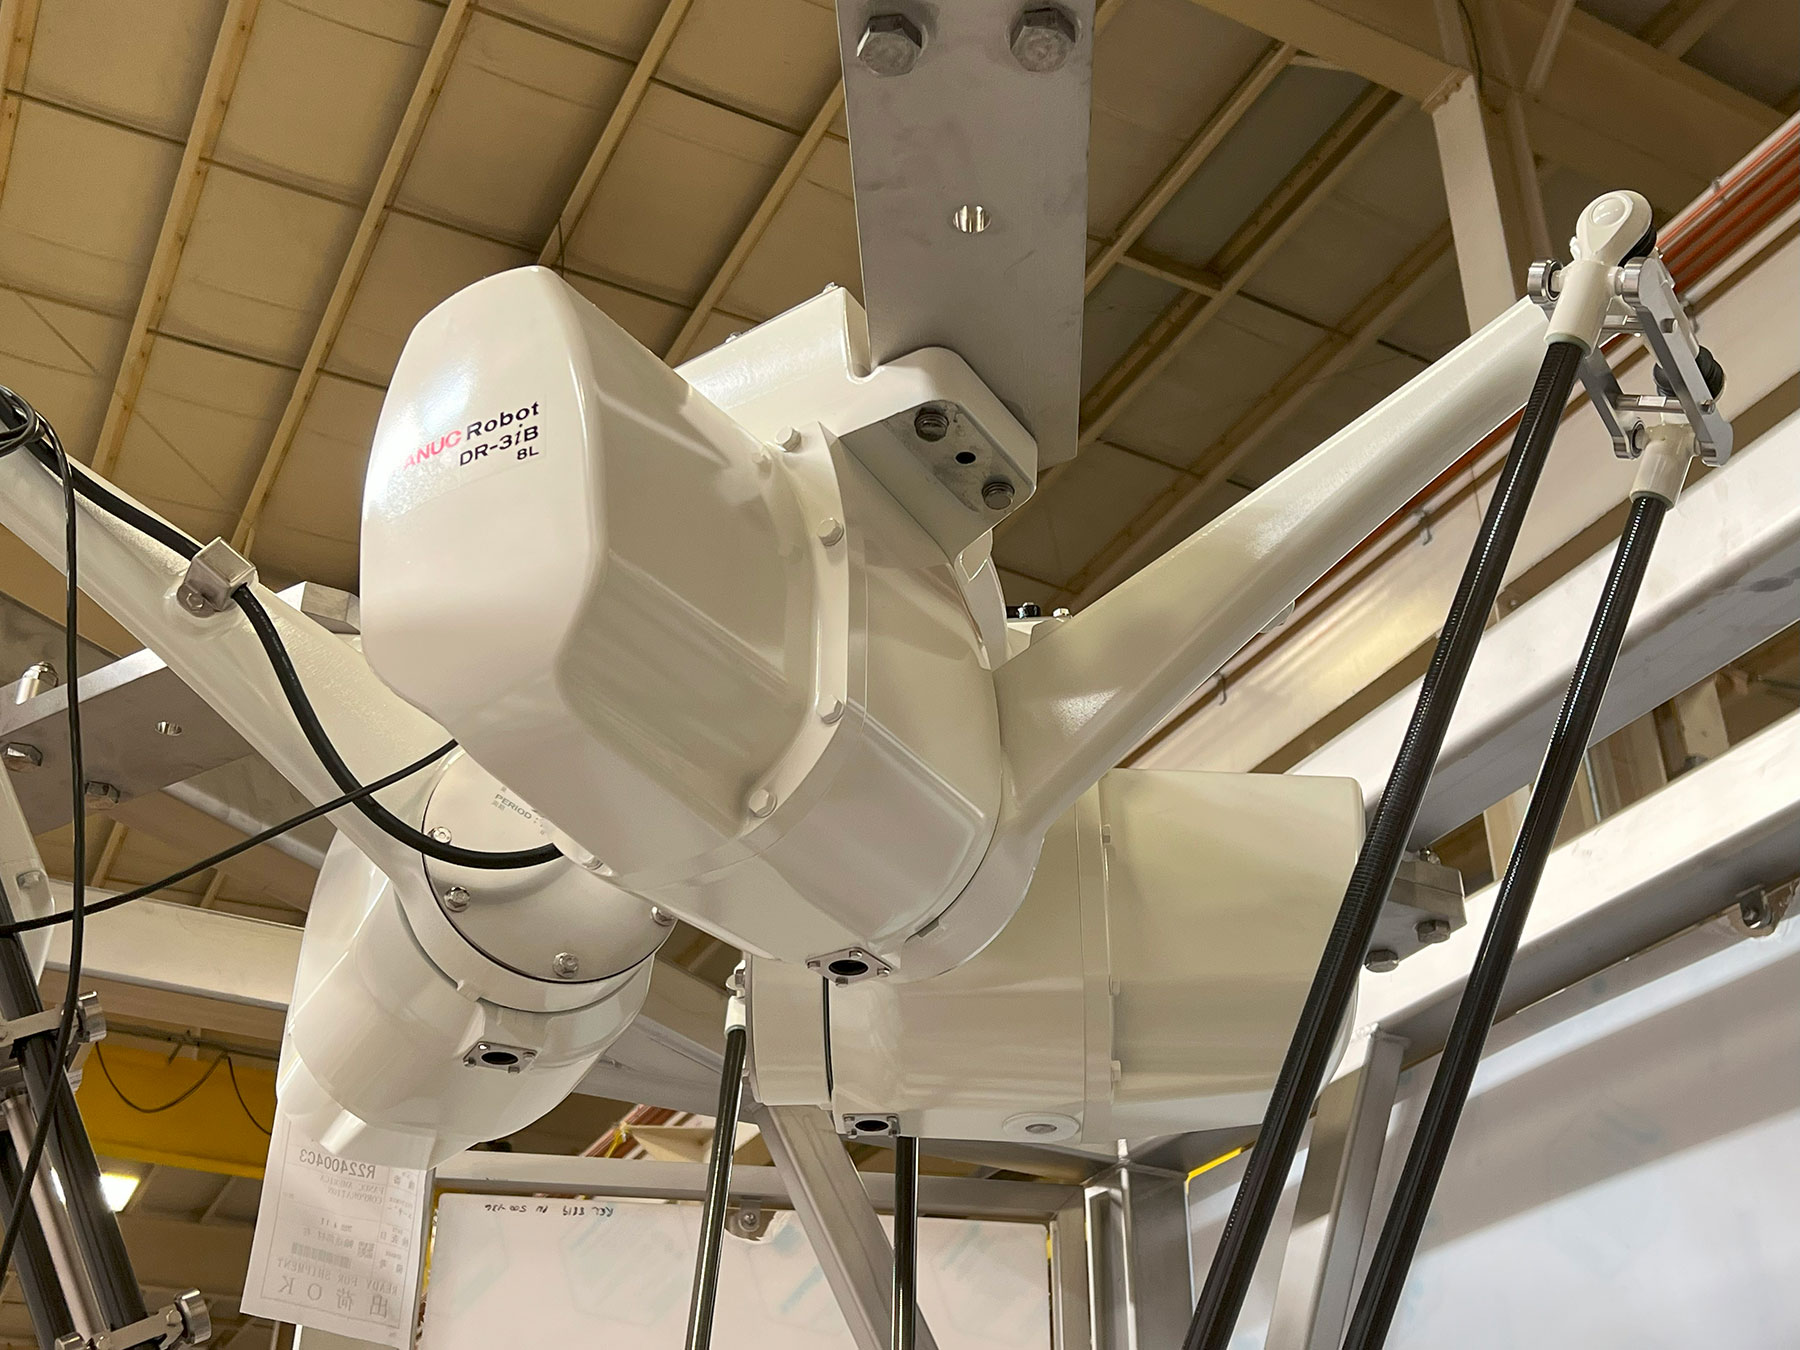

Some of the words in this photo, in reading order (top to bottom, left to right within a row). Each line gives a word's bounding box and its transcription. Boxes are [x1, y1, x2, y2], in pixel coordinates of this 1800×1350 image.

[400, 430, 462, 470] ANUC
[466, 401, 539, 440] Robot
[459, 423, 538, 466] DR-3iB
[516, 446, 539, 460] 8L
[494, 793, 532, 819] PERIOD
